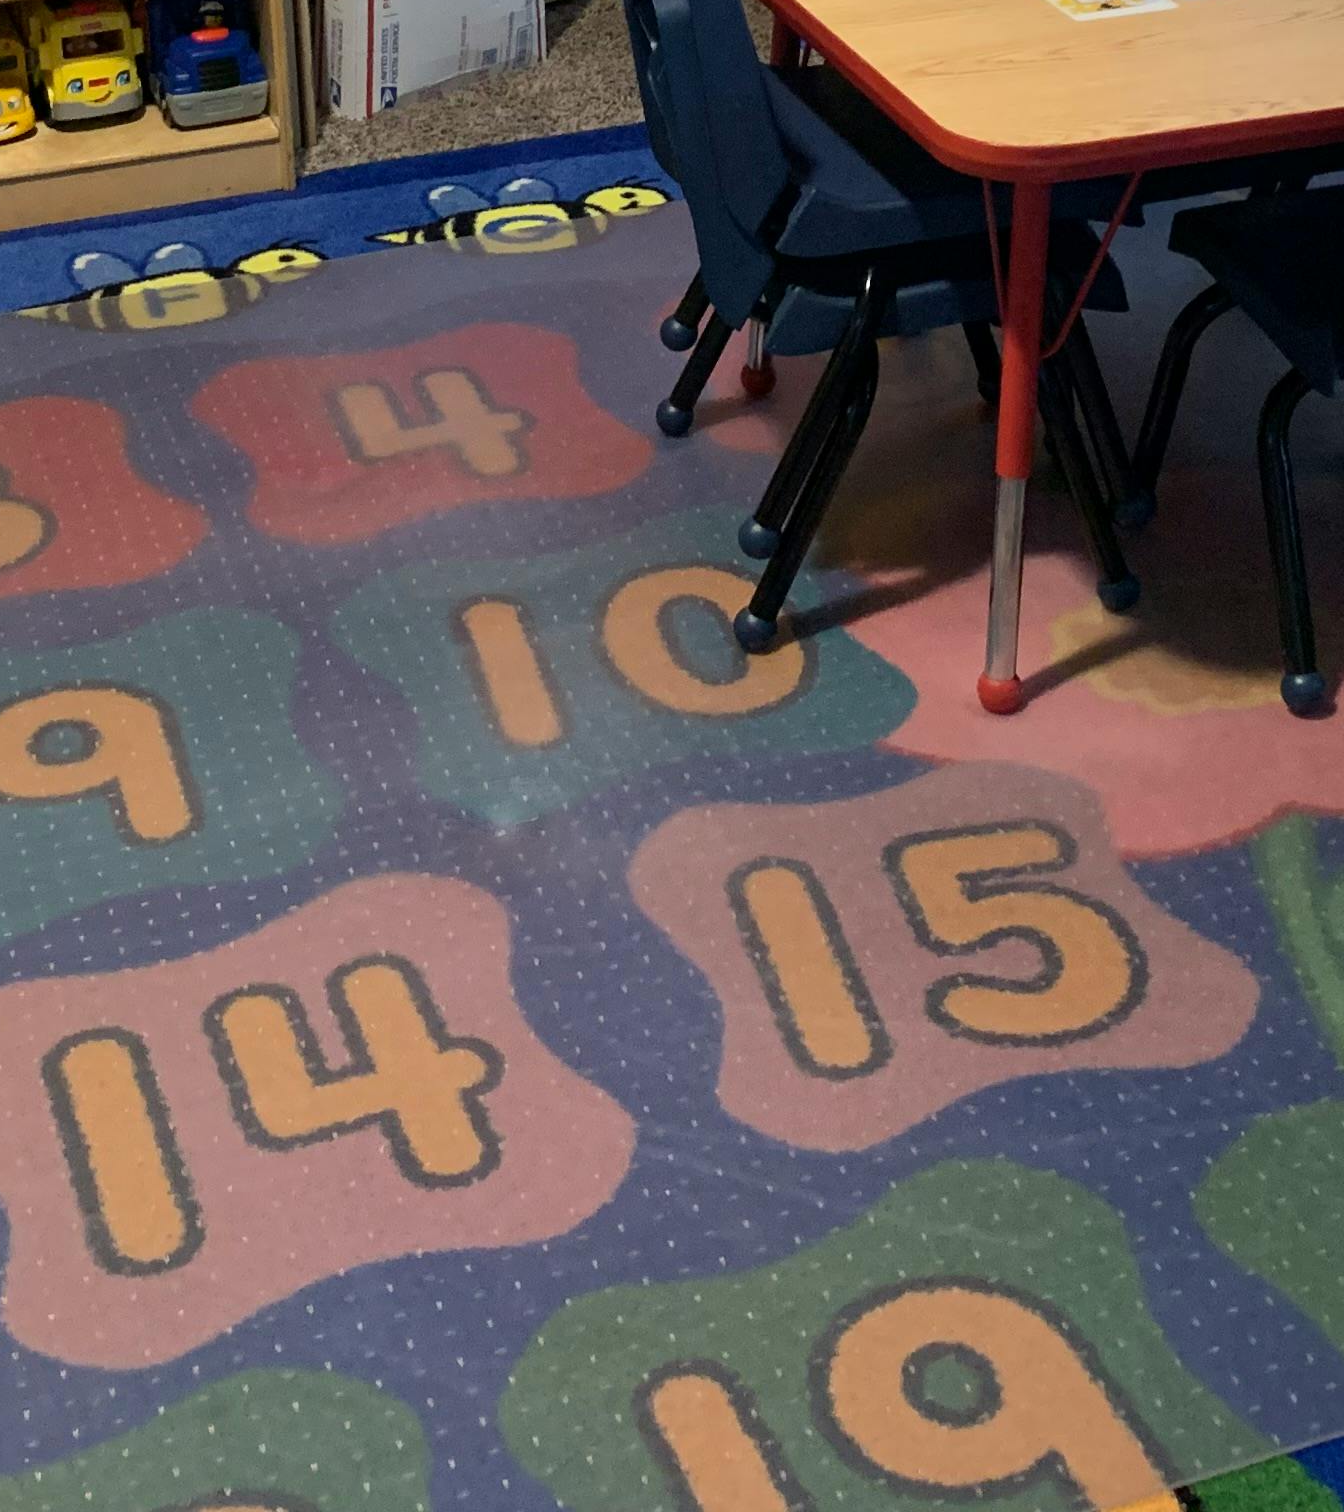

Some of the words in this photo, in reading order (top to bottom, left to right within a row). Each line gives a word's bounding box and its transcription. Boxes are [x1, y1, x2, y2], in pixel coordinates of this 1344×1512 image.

[138, 284, 205, 319] F
[328, 365, 536, 480] 4
[450, 562, 820, 753] 10
[725, 819, 1150, 1081] 15
[42, 951, 504, 1278] 14
[631, 1274, 1206, 1512] 19
